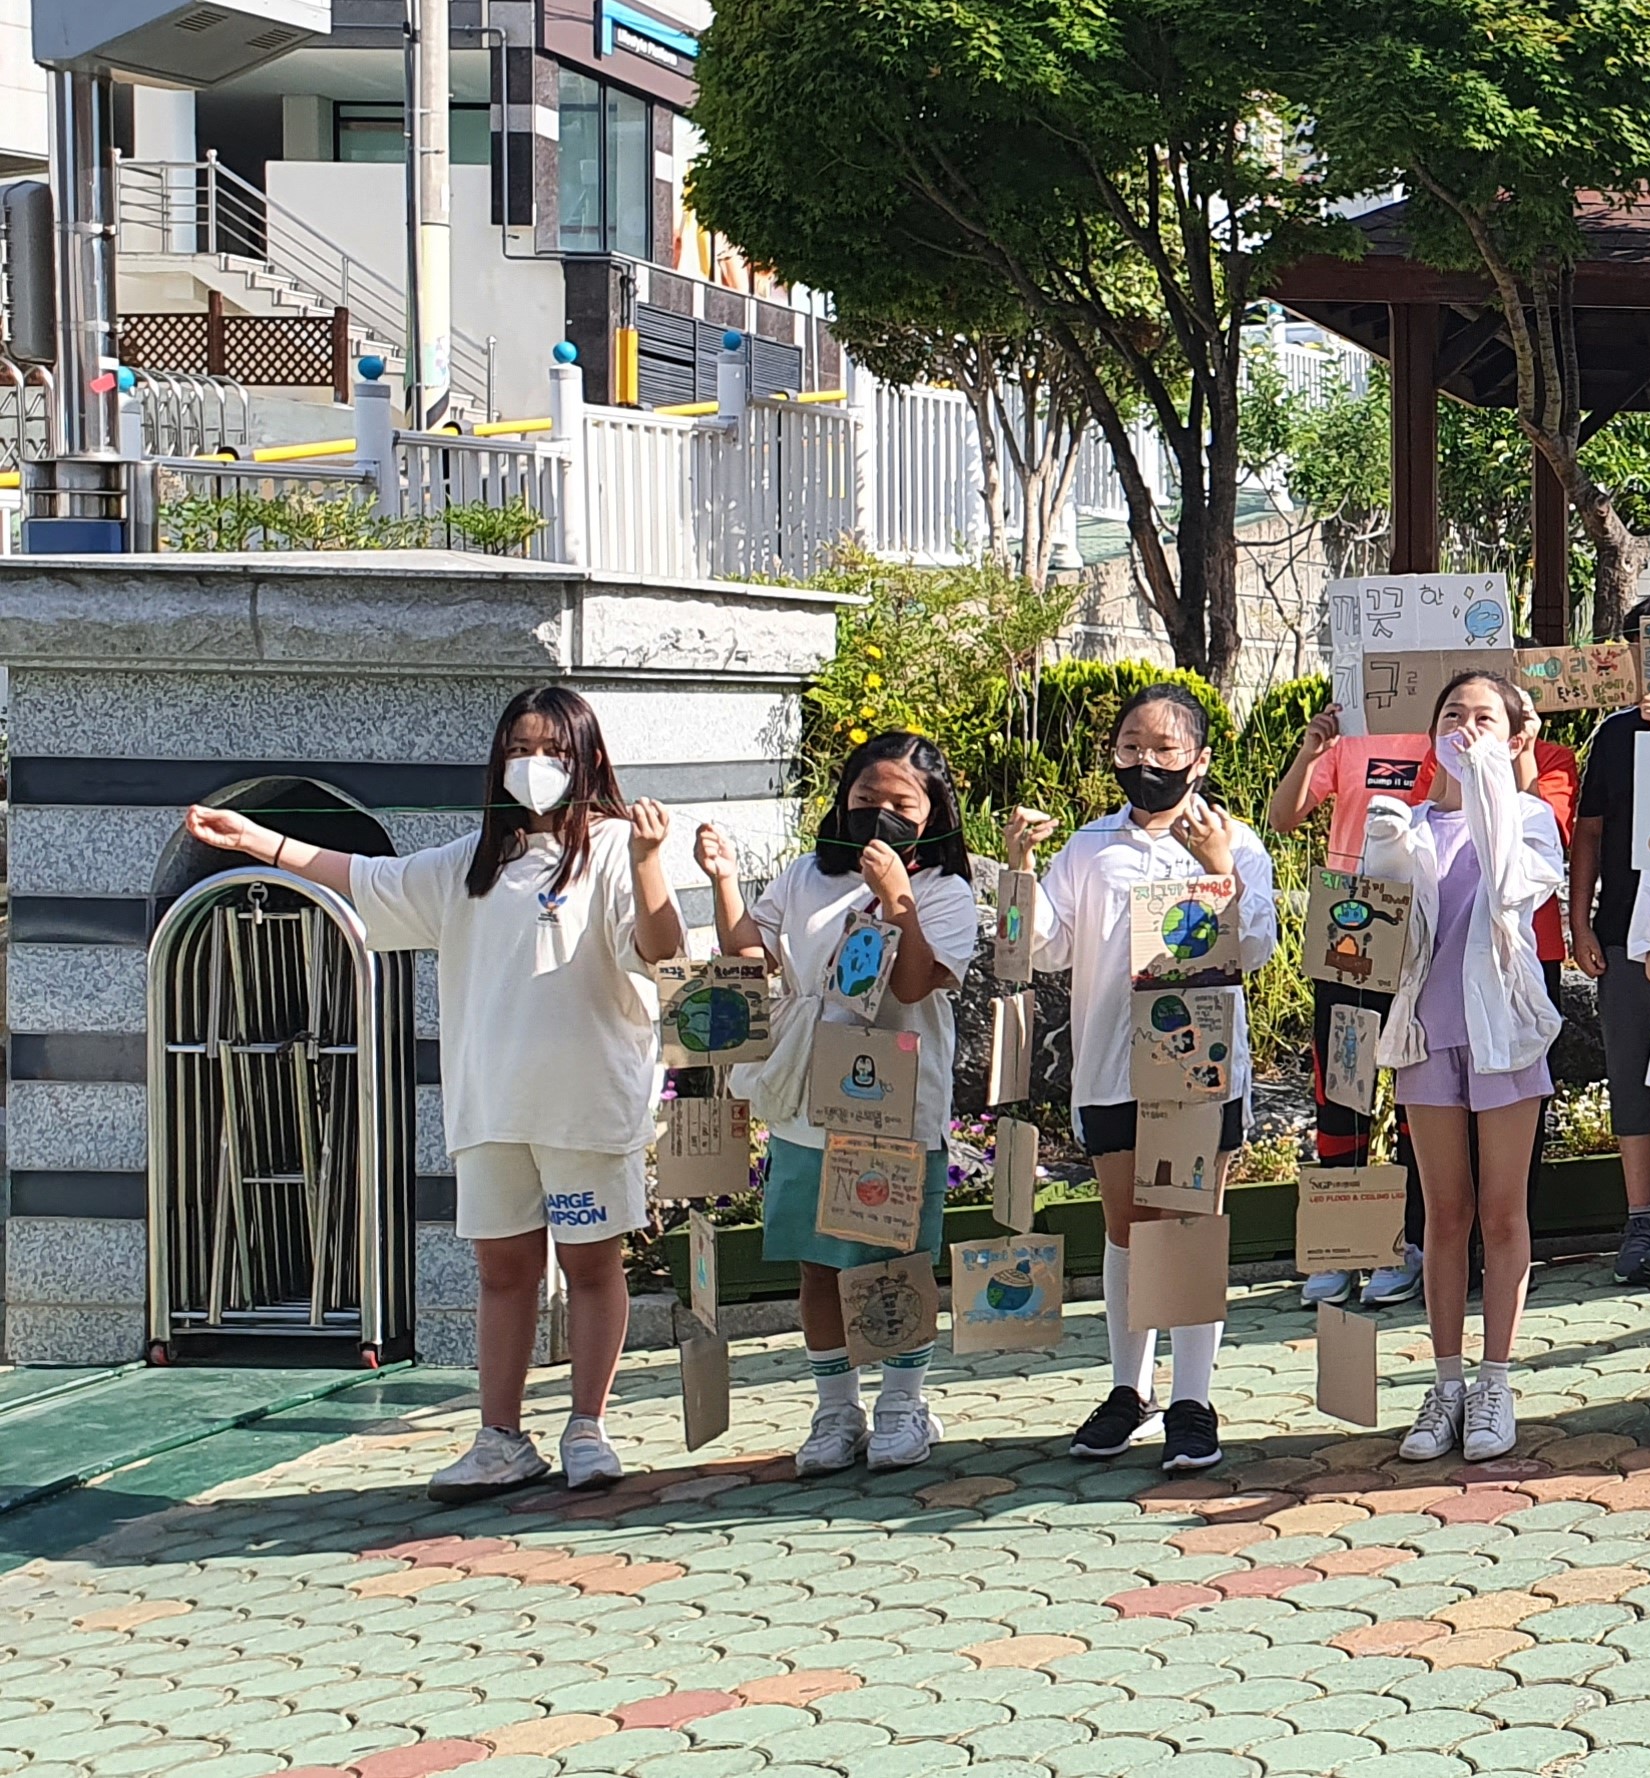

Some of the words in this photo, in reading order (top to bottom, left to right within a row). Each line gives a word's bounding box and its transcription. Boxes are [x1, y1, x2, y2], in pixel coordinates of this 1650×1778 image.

[1367, 777, 1393, 786] pump
[547, 1191, 595, 1209] ARGE
[1326, 1194, 1351, 1202] FLOOD
[1360, 1193, 1390, 1201] CEILING
